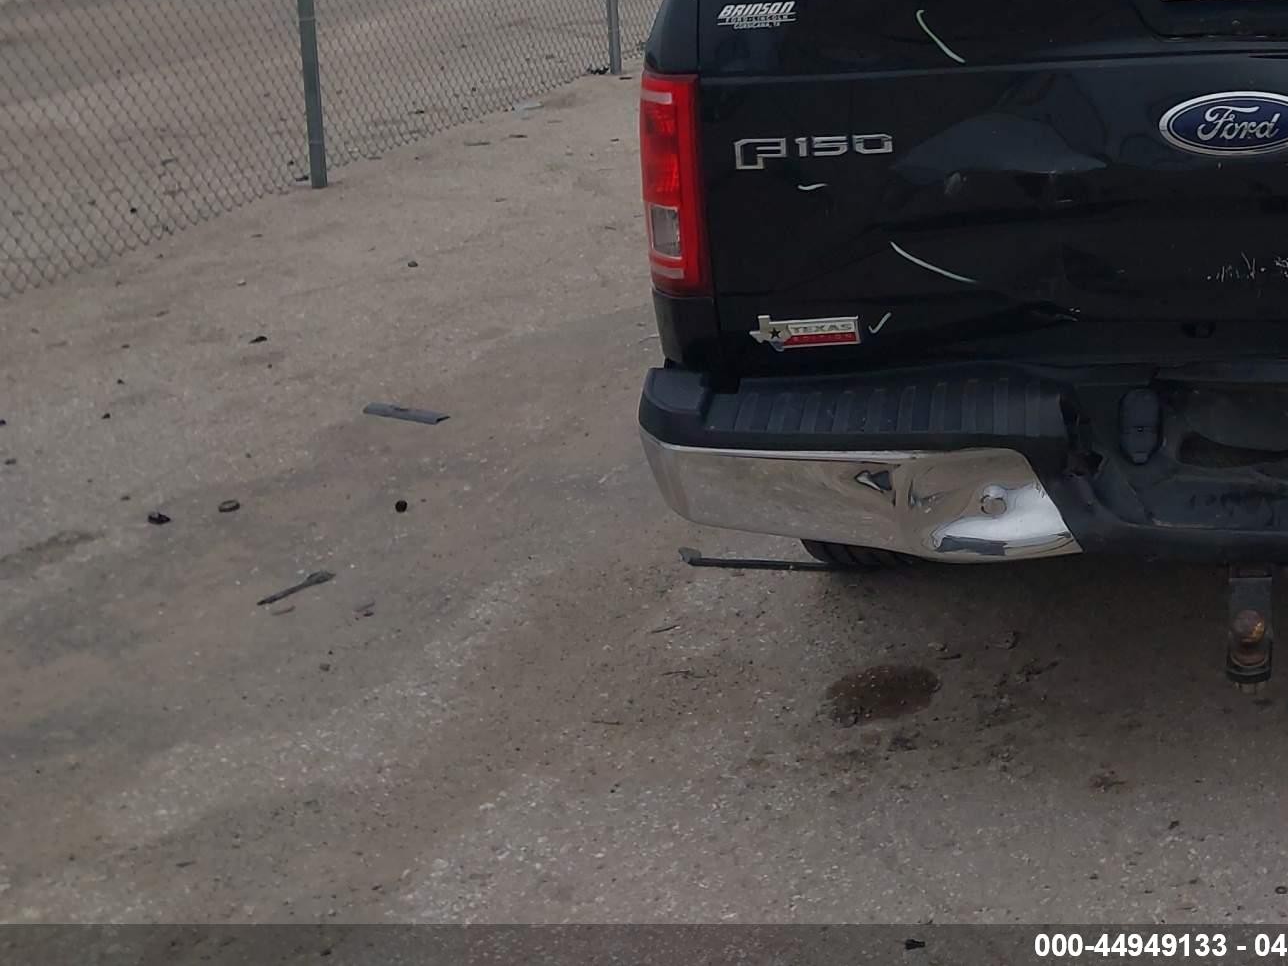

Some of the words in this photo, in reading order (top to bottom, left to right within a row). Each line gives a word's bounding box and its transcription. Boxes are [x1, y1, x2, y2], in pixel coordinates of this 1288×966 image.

[718, 1, 795, 19] BRINSON
[1197, 105, 1281, 141] Ford
[791, 322, 853, 334] TEXAS
